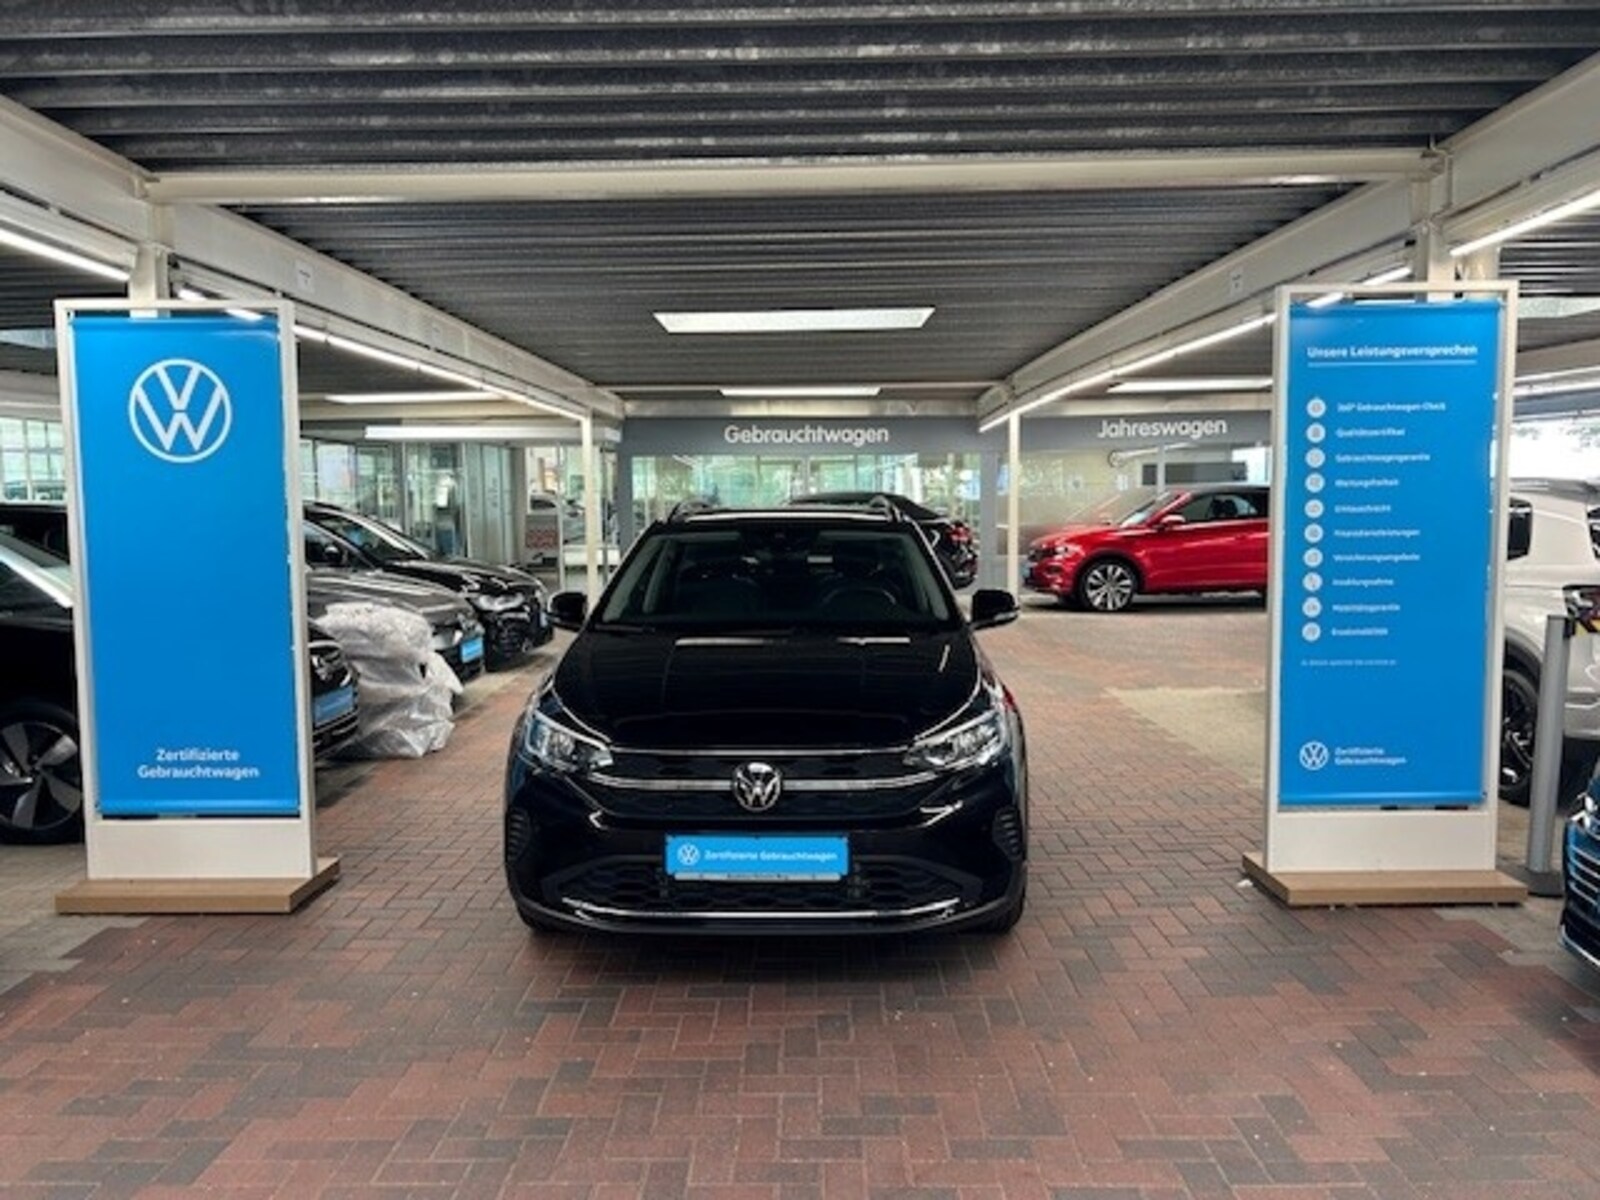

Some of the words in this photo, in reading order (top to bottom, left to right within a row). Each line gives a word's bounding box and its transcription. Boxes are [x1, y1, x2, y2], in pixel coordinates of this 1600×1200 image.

[1306, 347, 1348, 358] Unsere
[1350, 344, 1479, 359] Leistungsversprechen
[724, 424, 890, 447] Gebrauchtwagen
[1098, 417, 1229, 439] Jahreswagen
[156, 748, 240, 762] Zertifizierte
[1335, 756, 1407, 766] Gebrauchtwagen
[137, 764, 260, 781] Gebrauchtwagen
[760, 850, 838, 863] Gebrauchtwagen
